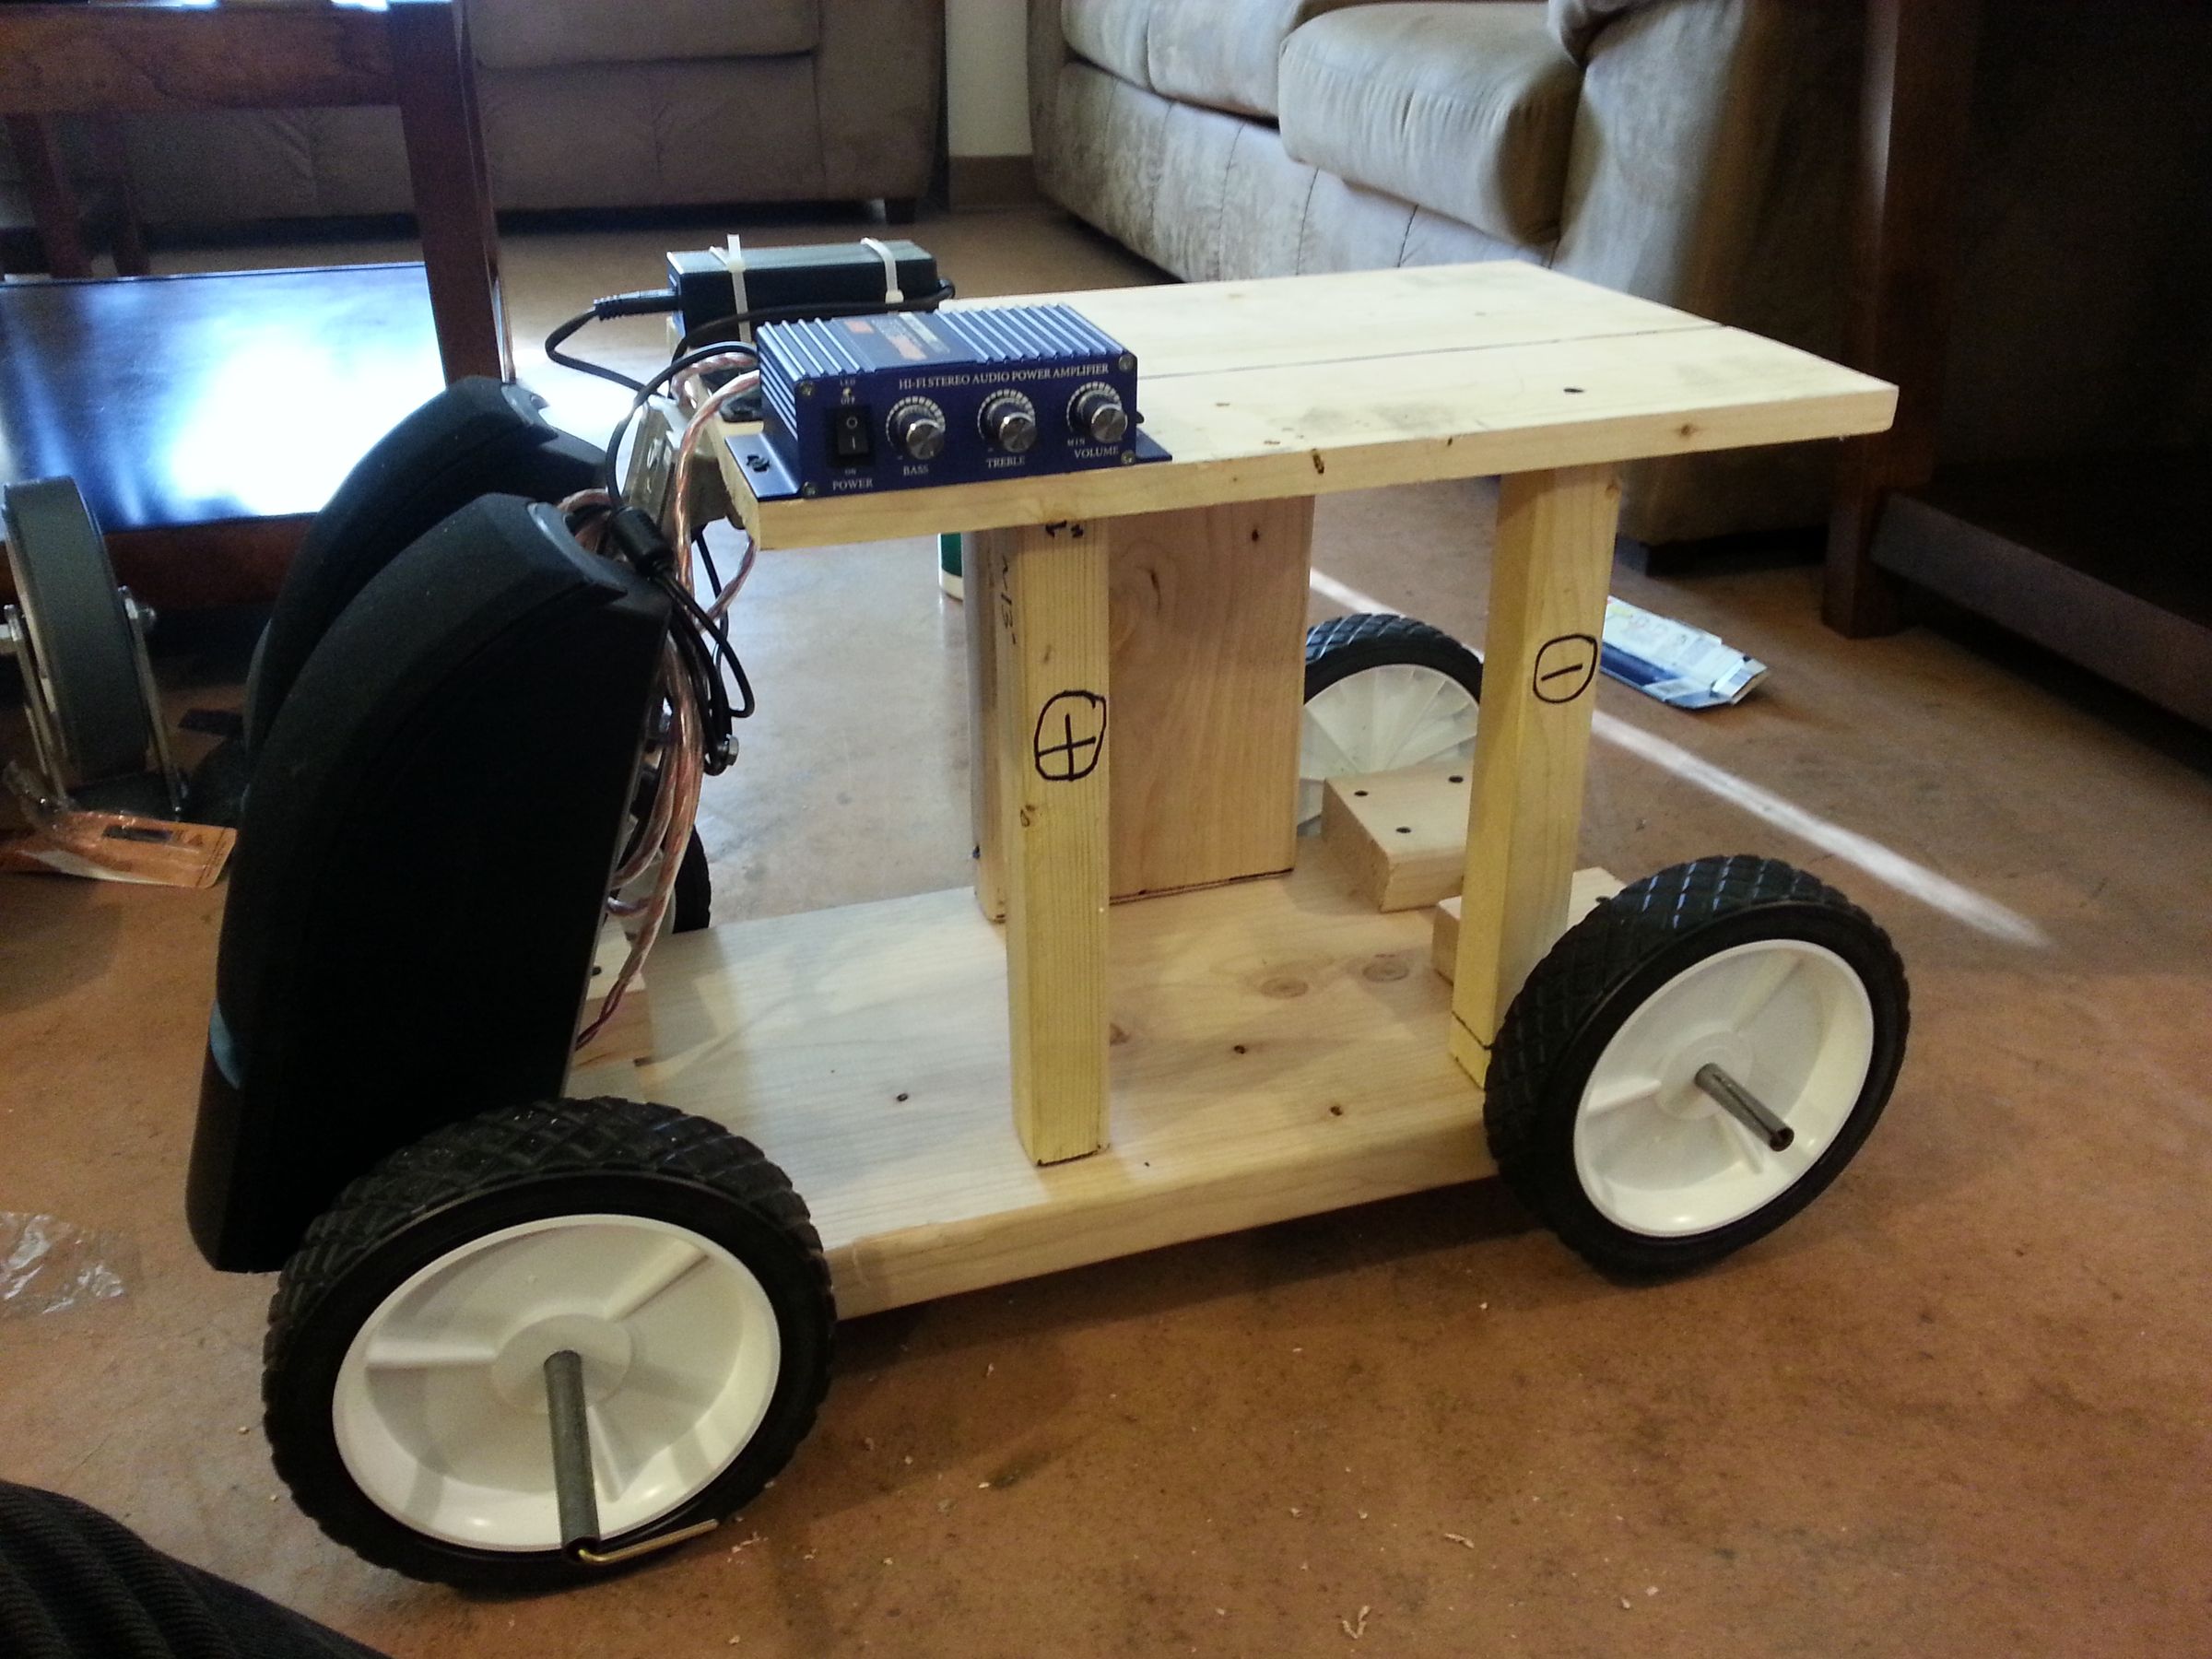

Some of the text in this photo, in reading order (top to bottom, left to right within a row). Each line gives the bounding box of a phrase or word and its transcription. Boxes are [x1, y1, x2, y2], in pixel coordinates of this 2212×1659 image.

[927, 373, 971, 387] STEREO
[972, 371, 1010, 384] AUDIO
[1011, 368, 1052, 382] POWER
[1053, 363, 1109, 379] AMPLIFIER
[1074, 445, 1119, 459] VOLUME
[986, 455, 1026, 468] TREBLE
[902, 465, 929, 476] BASS
[832, 478, 874, 490] POWER
